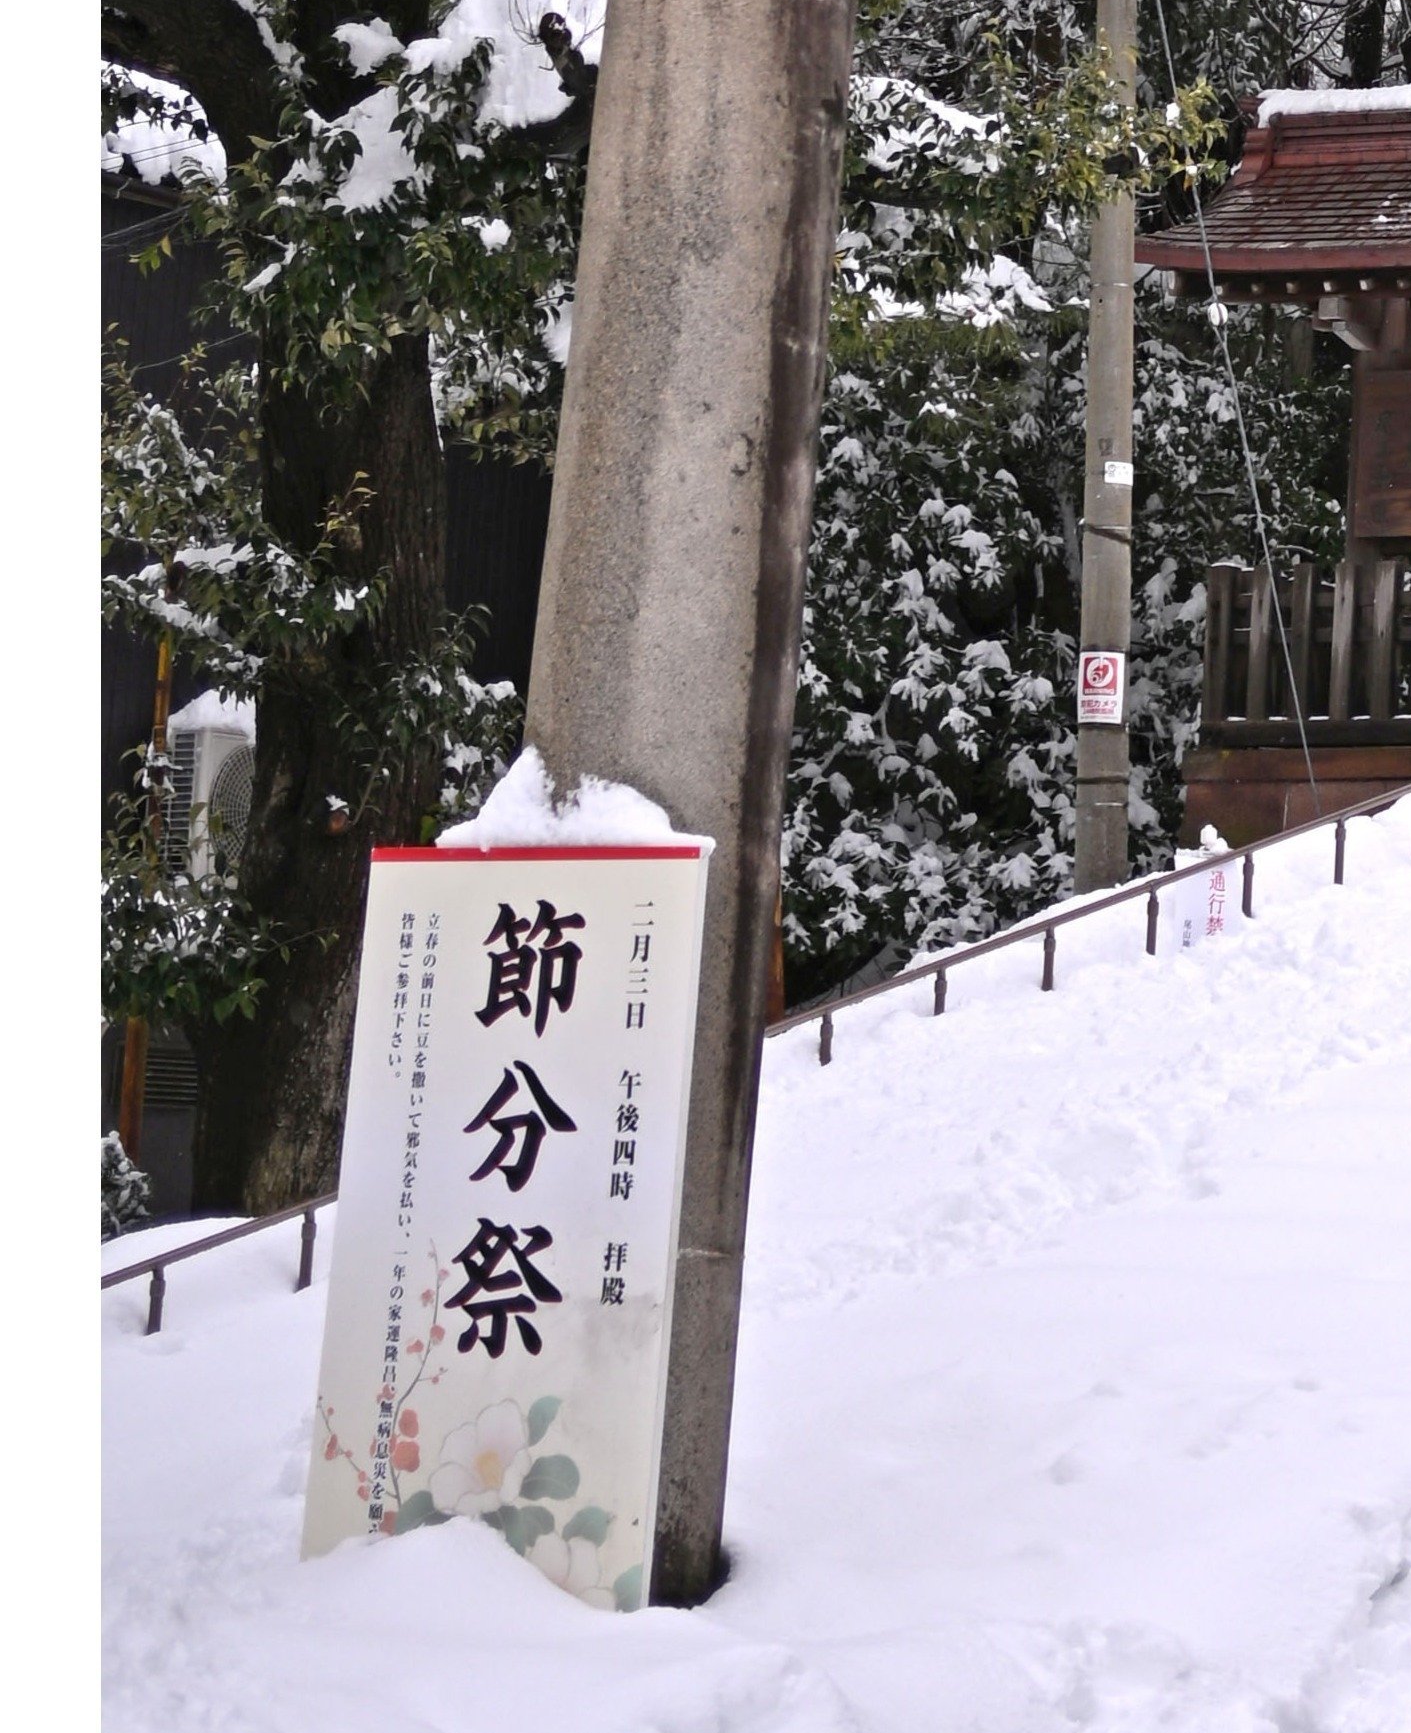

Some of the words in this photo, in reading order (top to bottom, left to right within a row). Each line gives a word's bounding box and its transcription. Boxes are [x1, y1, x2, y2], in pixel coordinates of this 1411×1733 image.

[624, 899, 656, 1031] 二月三日
[443, 899, 587, 1360] 節分祭
[609, 1069, 642, 1201] 午後四時
[600, 1241, 629, 1306] 拝殿
